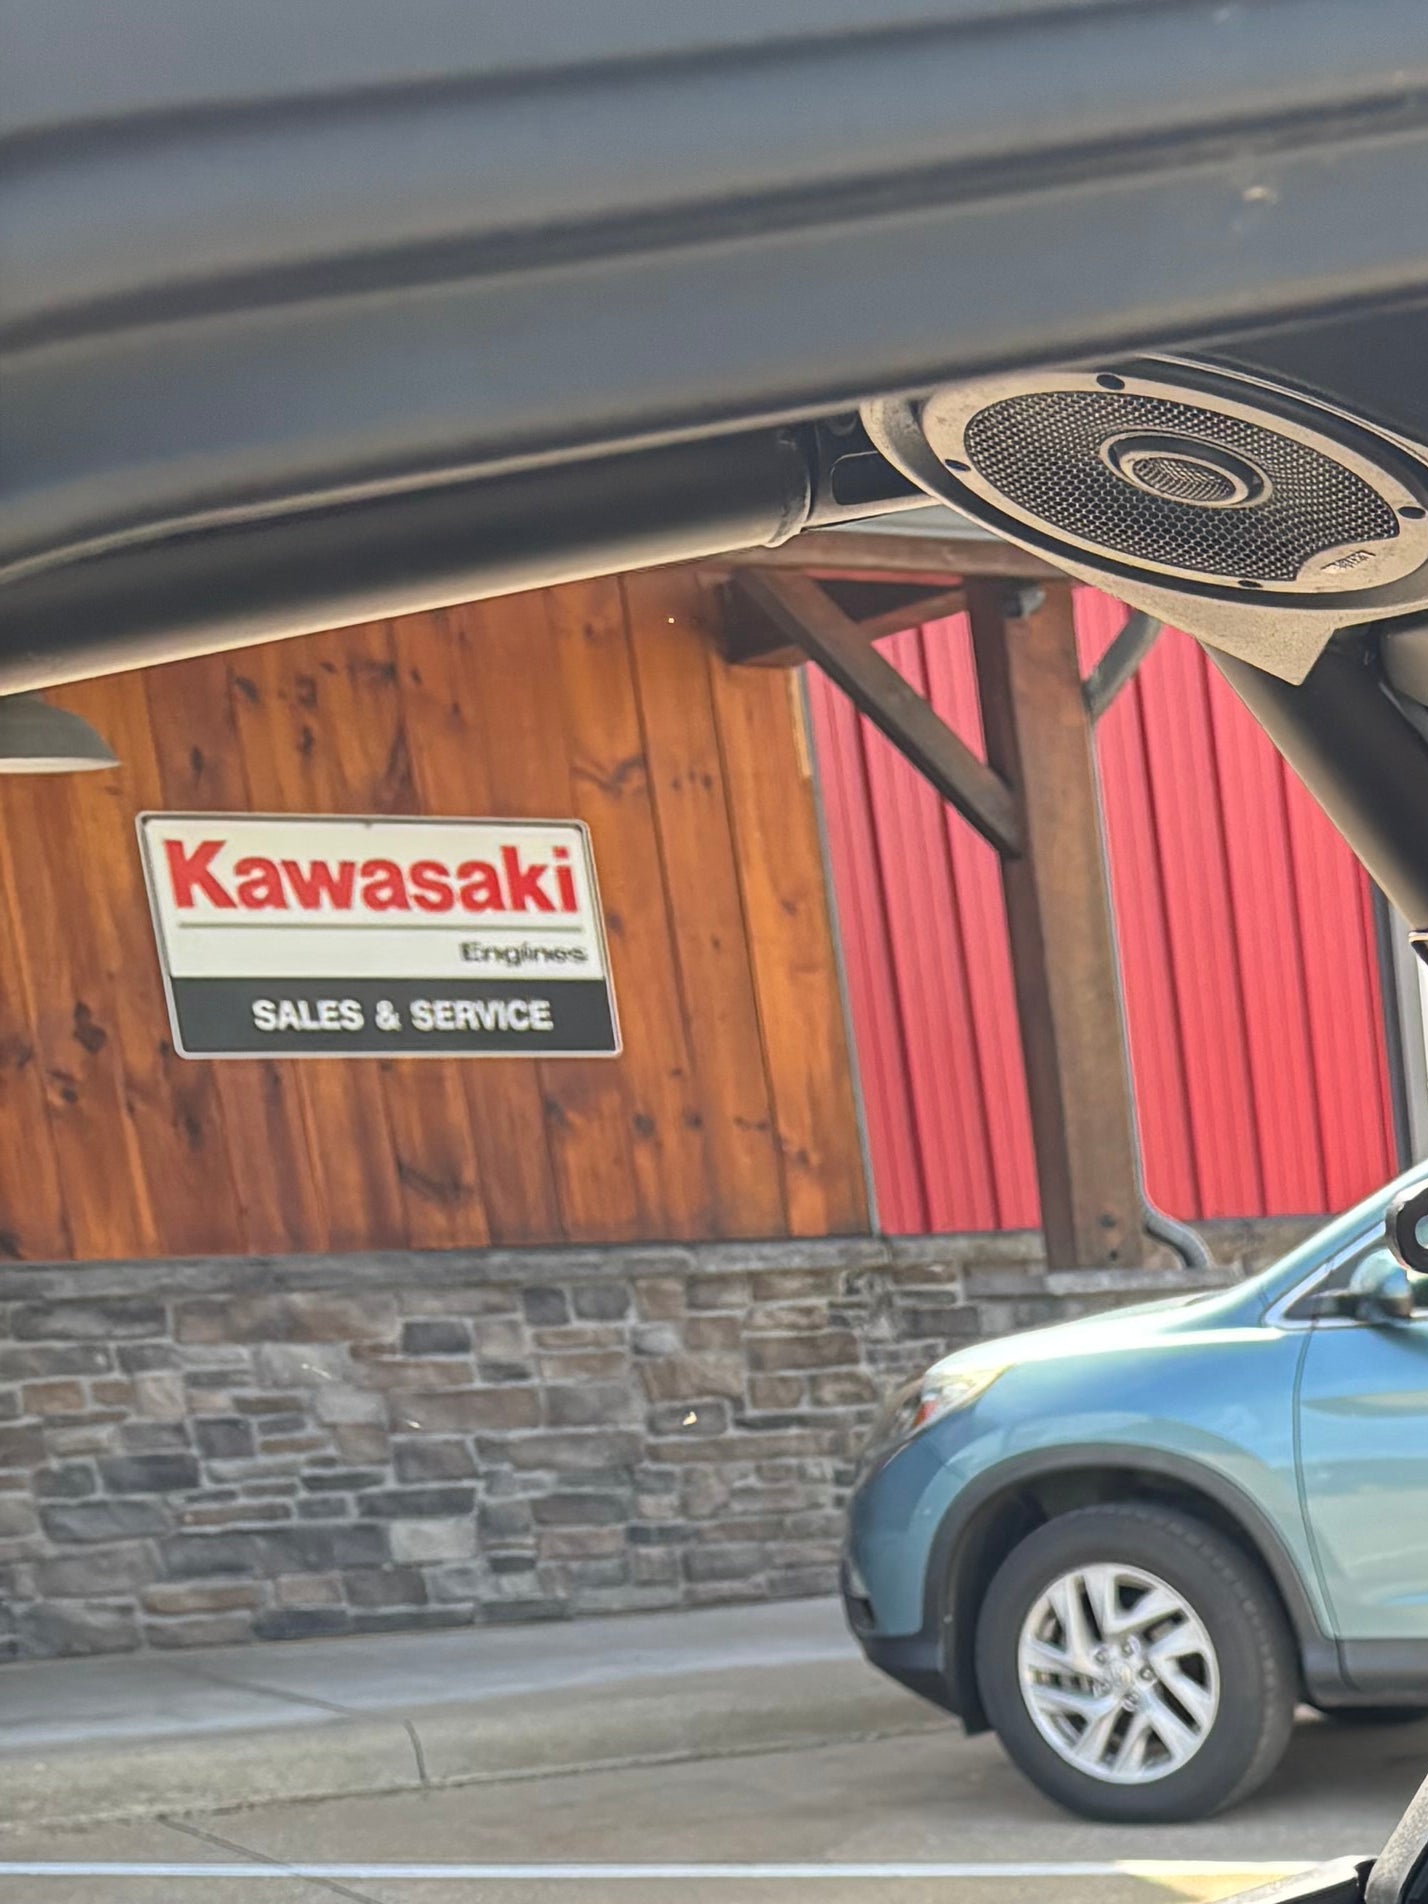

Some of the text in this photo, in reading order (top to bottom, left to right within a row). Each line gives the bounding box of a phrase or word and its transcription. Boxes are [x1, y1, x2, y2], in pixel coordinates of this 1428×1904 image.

[163, 839, 578, 914] Kawasaki
[459, 940, 588, 967] Engines
[252, 999, 554, 1032] SALES & SERVICE
